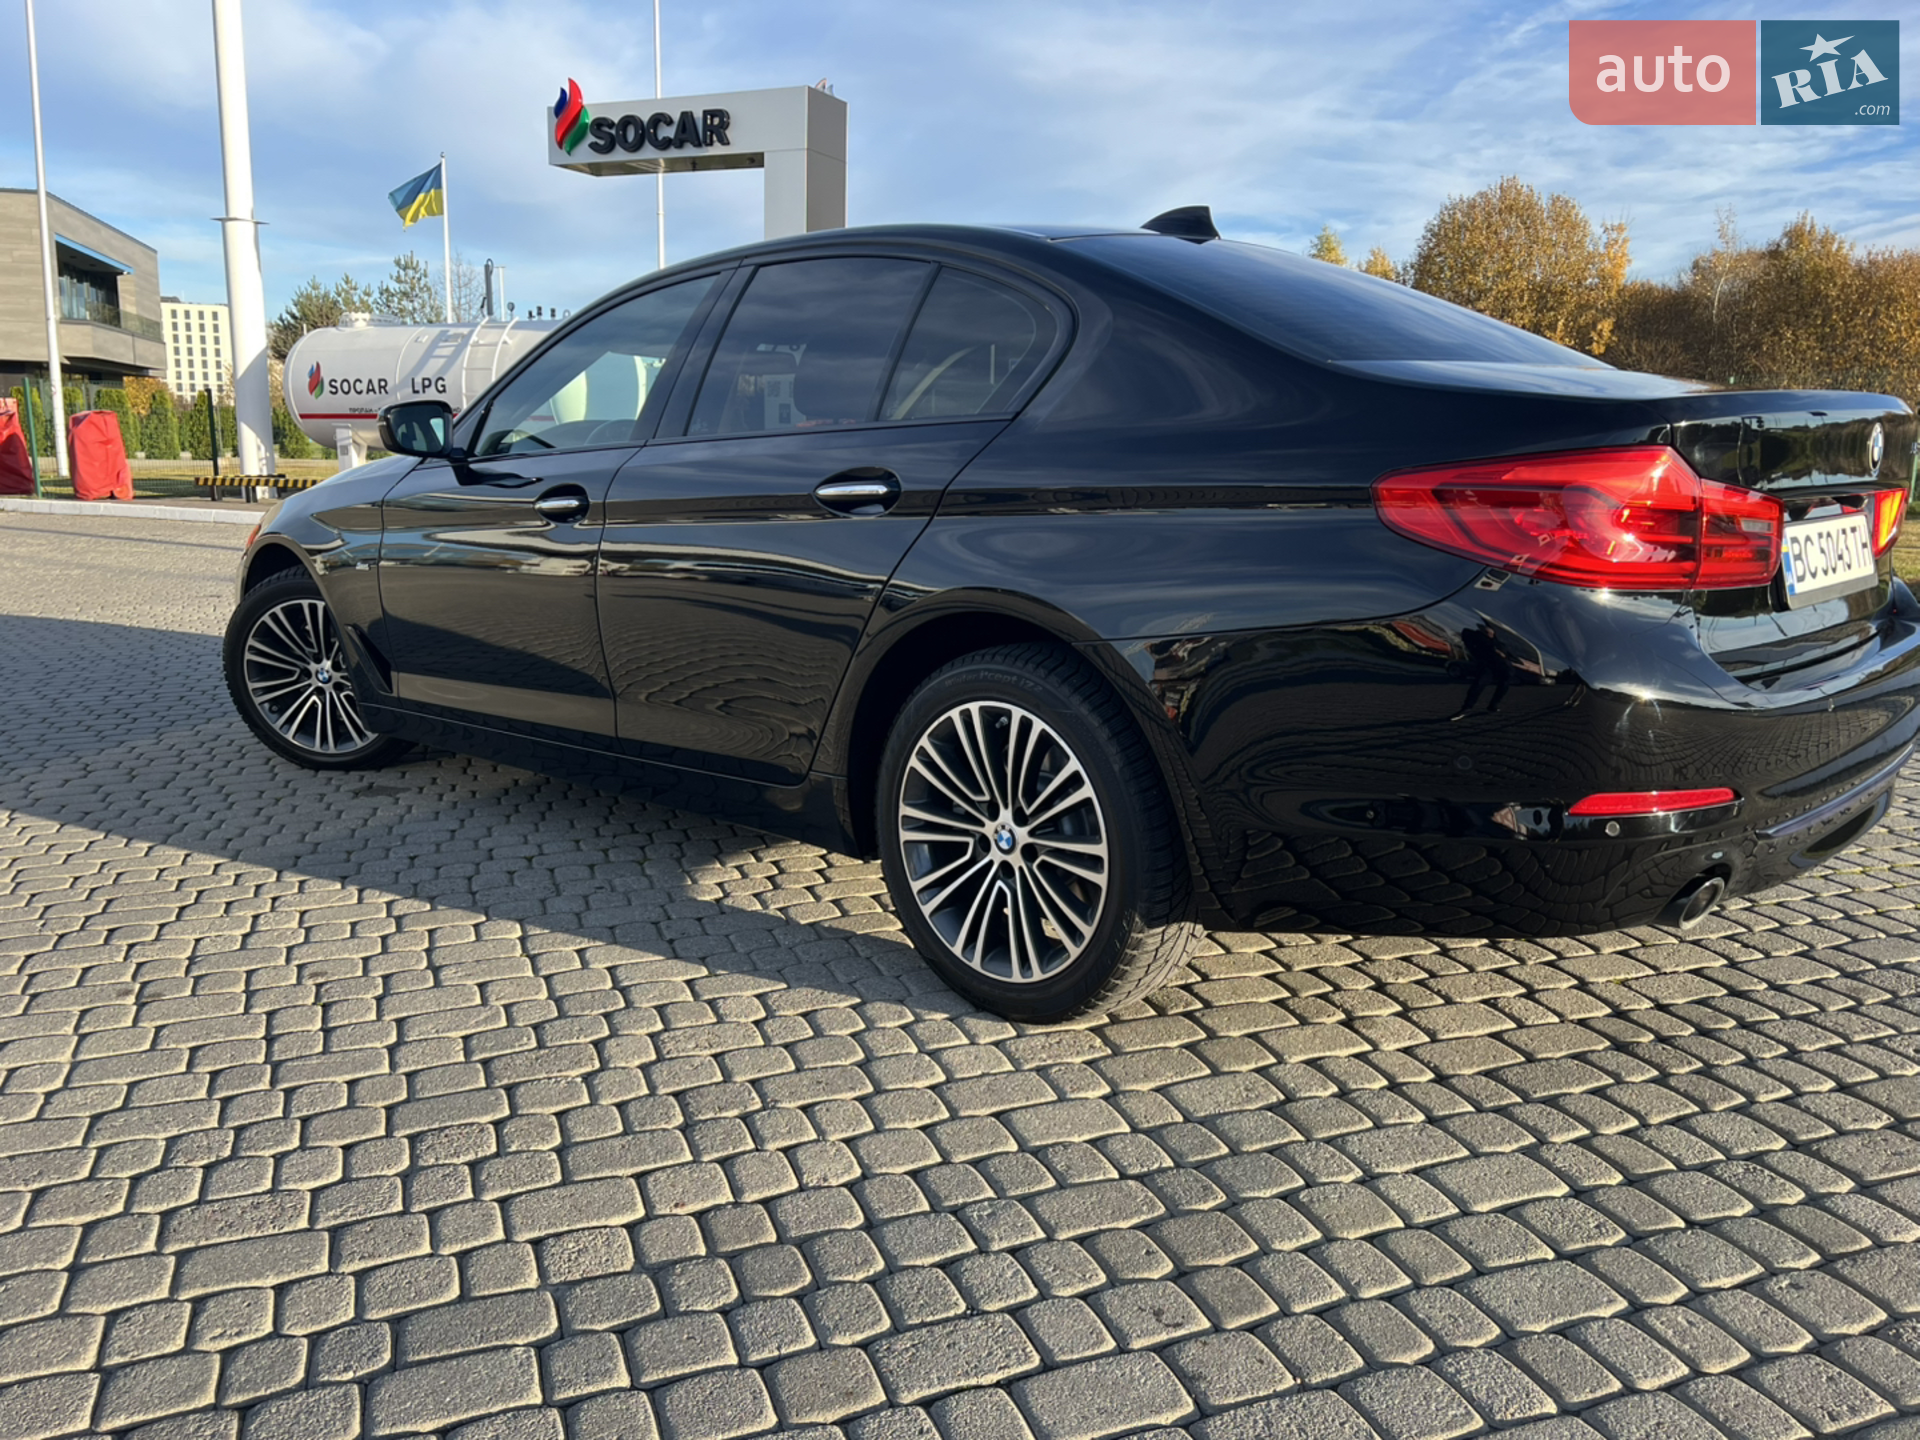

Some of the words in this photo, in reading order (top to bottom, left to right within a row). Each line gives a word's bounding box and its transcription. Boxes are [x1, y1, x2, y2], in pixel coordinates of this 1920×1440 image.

[588, 109, 730, 155] SOCAR
[328, 378, 389, 396] SOCAR
[411, 377, 447, 395] LPG
[1789, 535, 1818, 584] BC
[1817, 527, 1852, 577] 5043
[1850, 524, 1873, 569] TH
